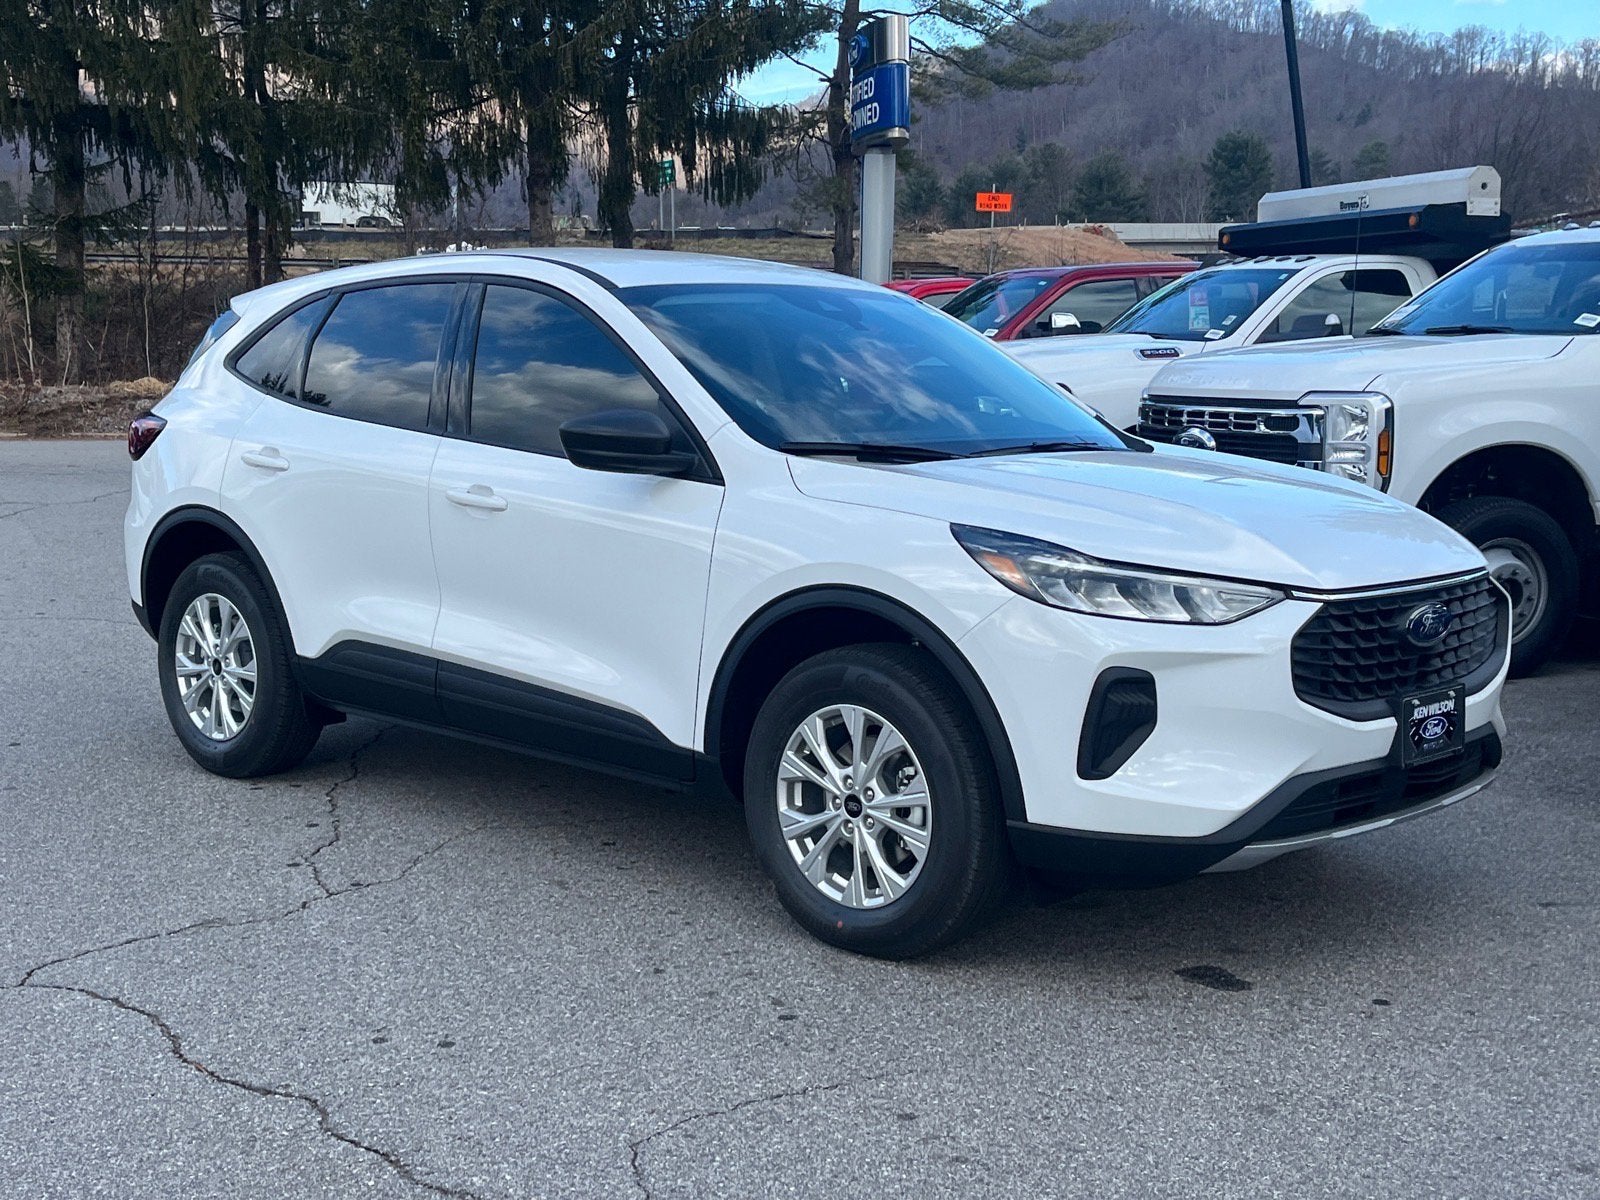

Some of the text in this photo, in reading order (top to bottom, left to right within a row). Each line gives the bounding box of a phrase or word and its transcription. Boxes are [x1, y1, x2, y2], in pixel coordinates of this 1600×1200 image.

[1413, 699, 1455, 719] KEN WILSON
[1425, 720, 1443, 736] Ford
